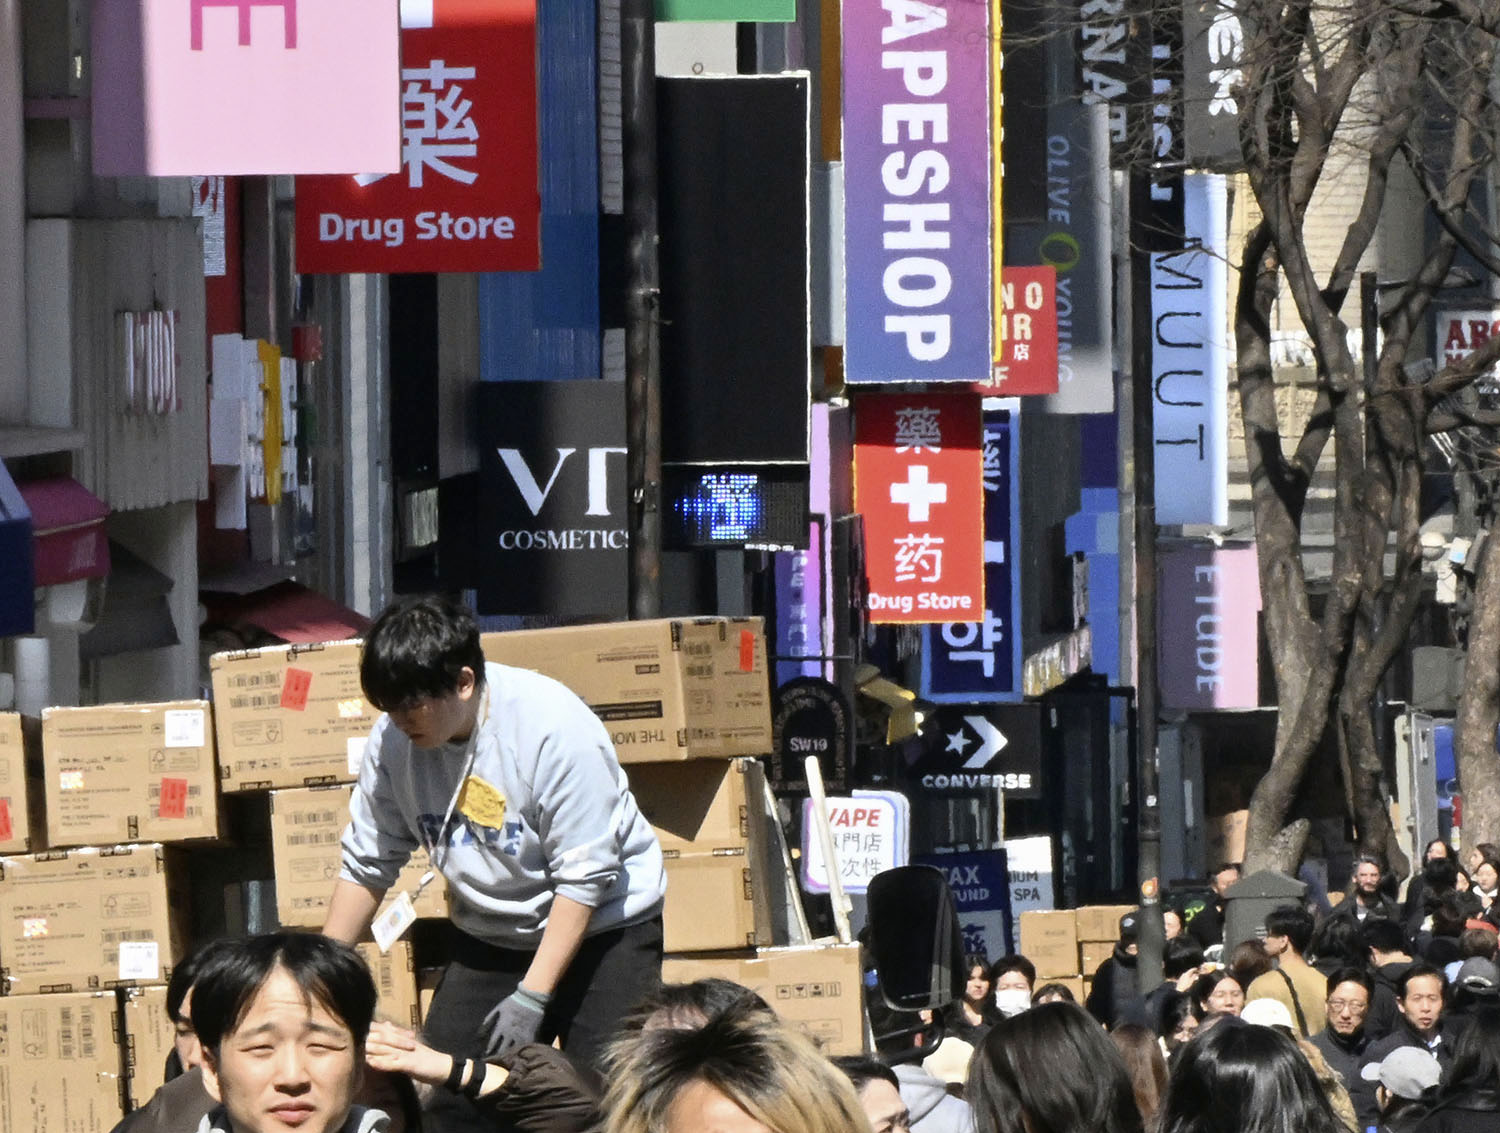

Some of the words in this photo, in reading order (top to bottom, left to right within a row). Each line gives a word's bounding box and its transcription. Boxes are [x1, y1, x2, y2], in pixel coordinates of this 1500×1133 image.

[1047, 135, 1071, 225] OLIVE
[319, 211, 405, 248] Drug
[414, 211, 516, 242] Store
[1155, 235, 1204, 460] MUUT
[895, 407, 941, 454] 藥
[497, 447, 629, 517] VT
[894, 533, 944, 583] 药
[869, 592, 913, 614] Drug
[917, 592, 972, 609] Store
[1195, 563, 1223, 694] ETUDE
[921, 774, 1032, 790] CONVERSE
[1014, 887, 1041, 901] SPA
